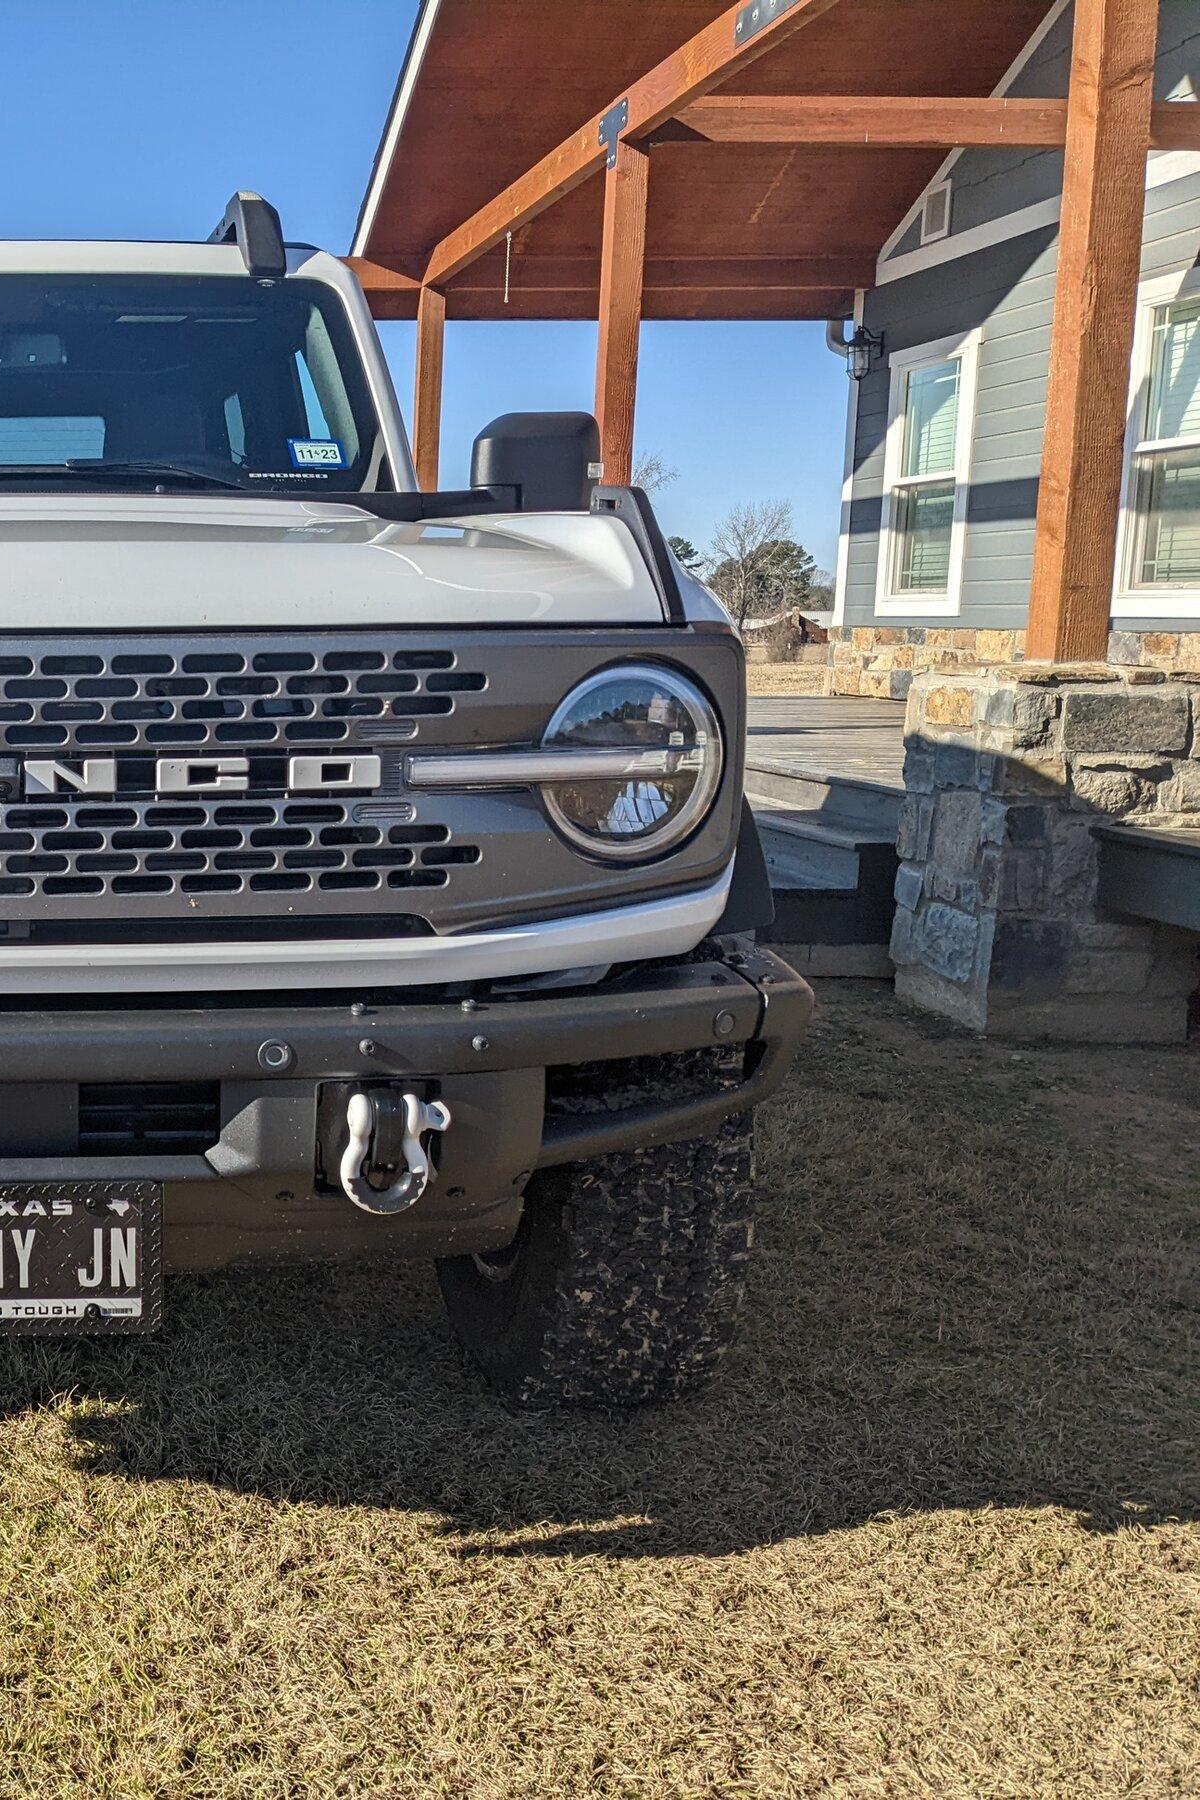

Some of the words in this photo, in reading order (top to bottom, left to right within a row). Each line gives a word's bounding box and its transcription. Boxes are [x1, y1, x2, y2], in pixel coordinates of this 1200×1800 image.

[298, 449, 314, 460] 11
[321, 449, 338, 460] 23
[77, 1227, 136, 1288] JN
[11, 1305, 77, 1316] TOUGH
